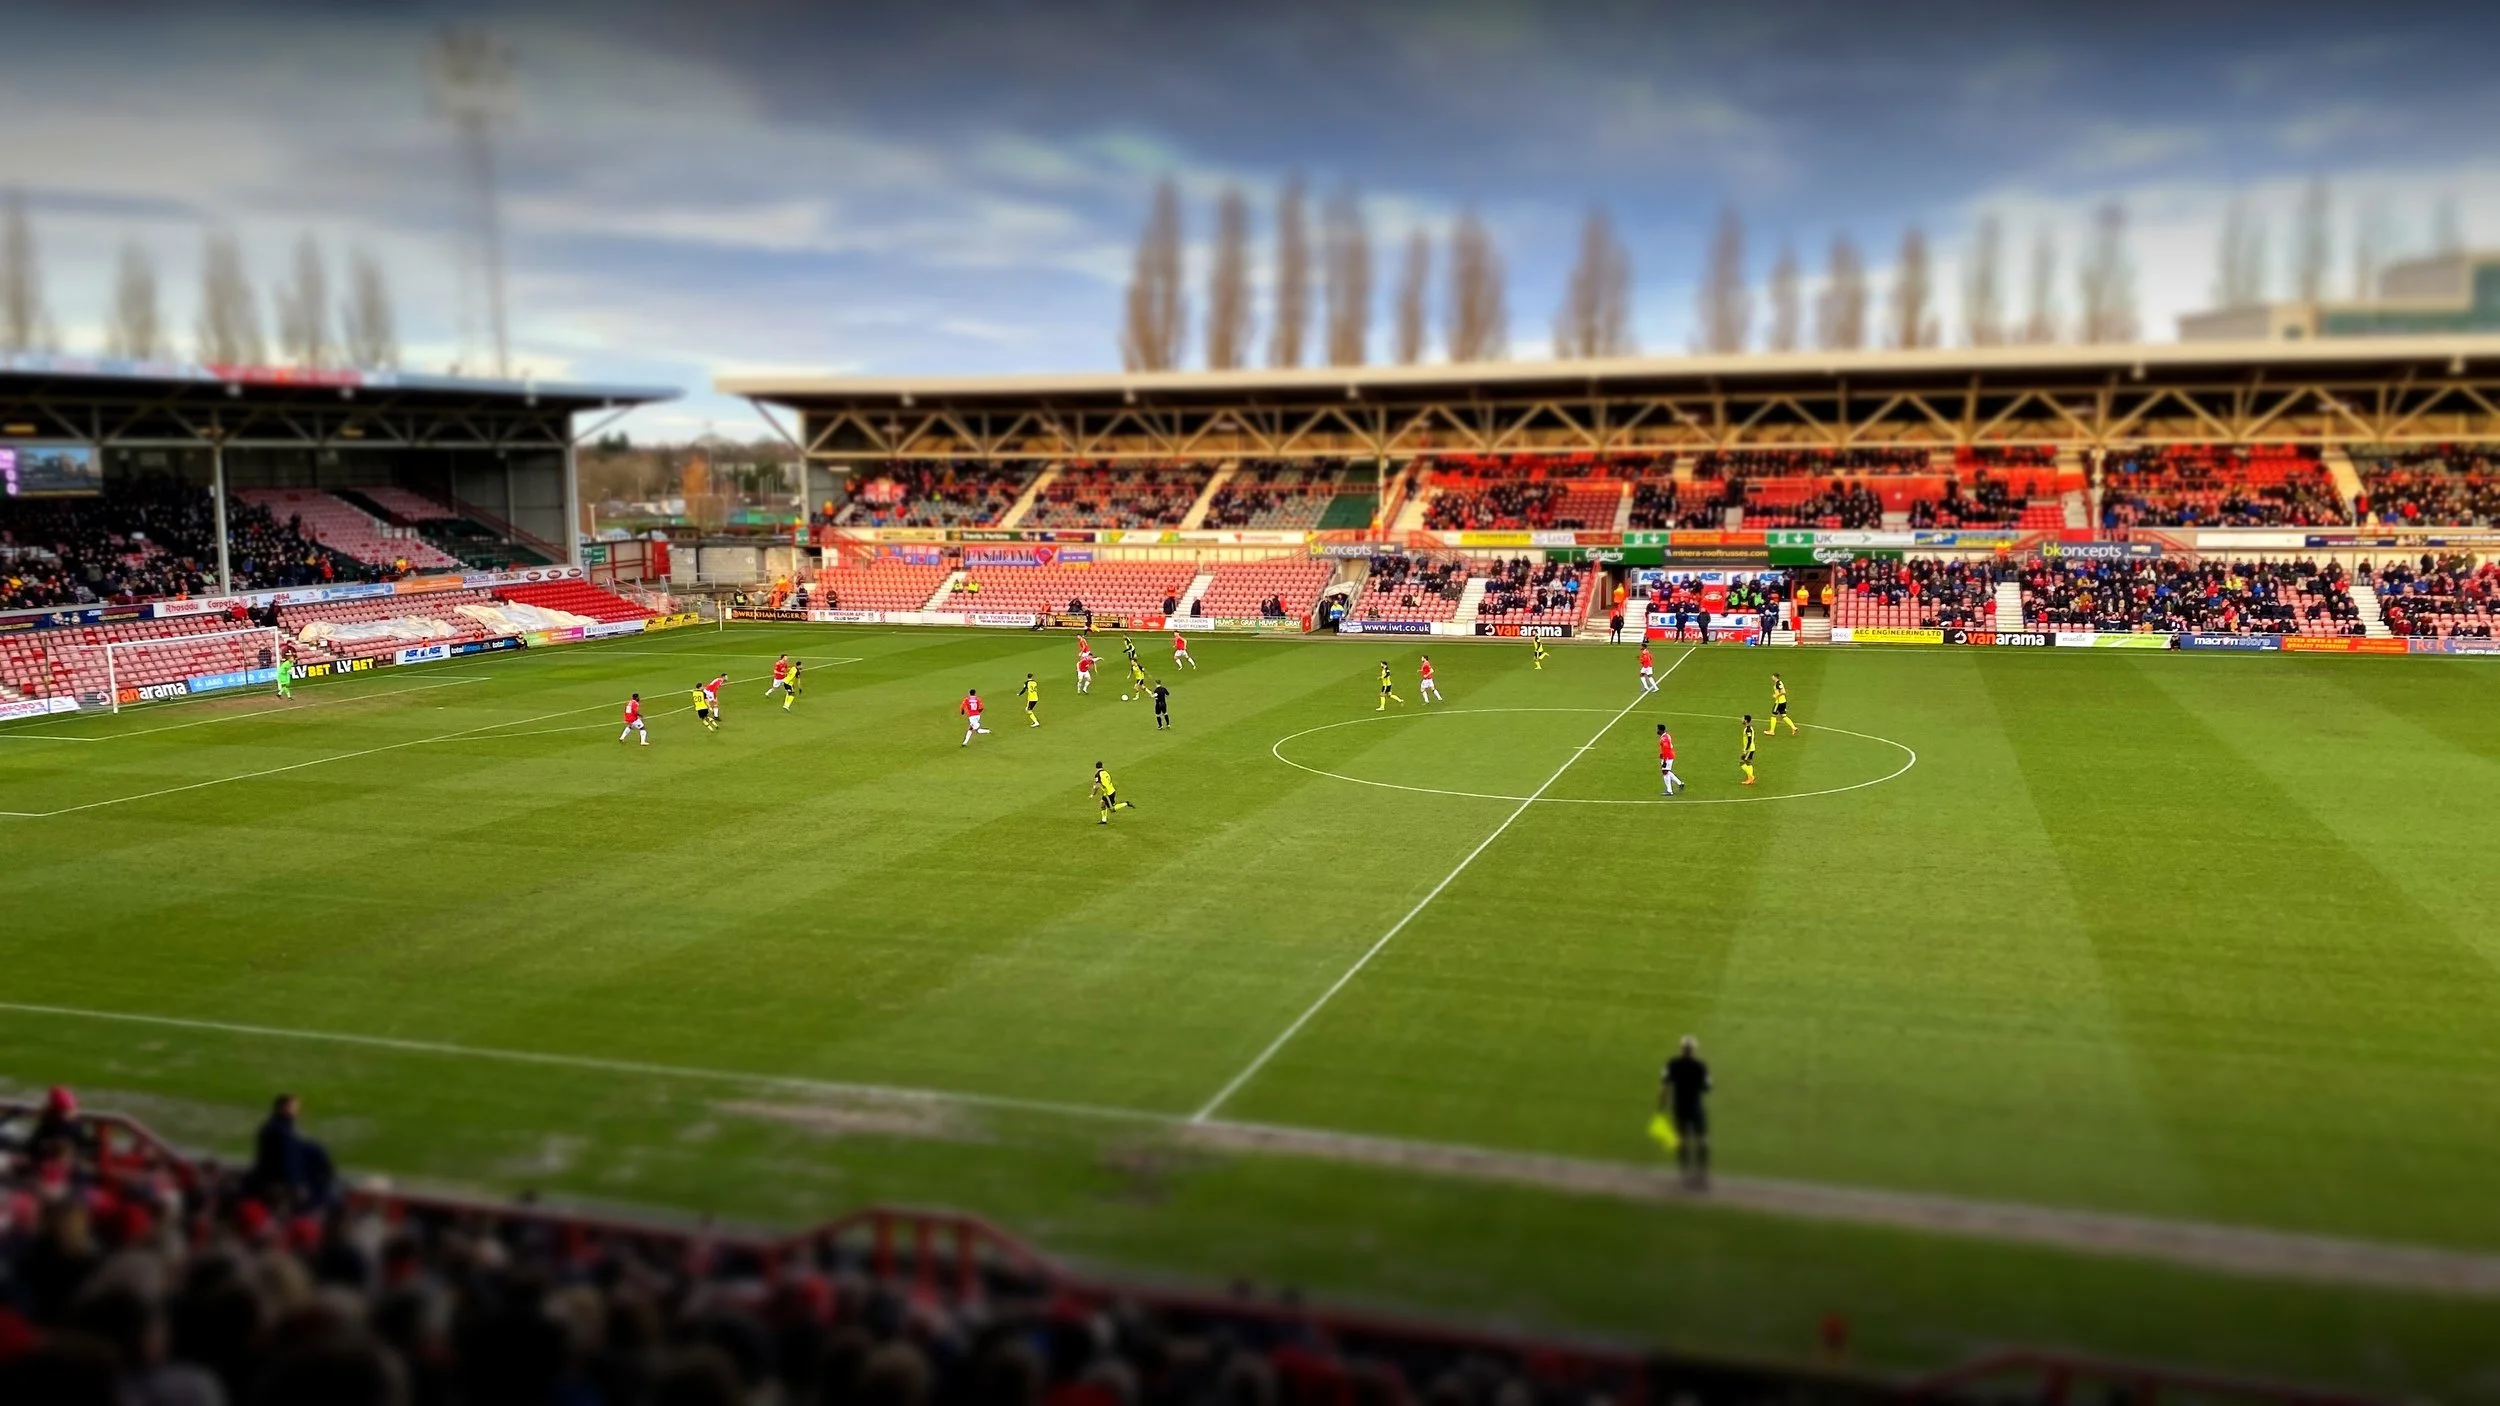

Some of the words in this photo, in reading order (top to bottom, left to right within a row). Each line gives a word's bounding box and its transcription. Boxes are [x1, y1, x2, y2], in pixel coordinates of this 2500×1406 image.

[963, 532, 983, 540] Travis
[985, 532, 1010, 540] Perkins
[1309, 542, 1372, 557] bkoncepts
[1585, 548, 1624, 562] Carlsberg
[1672, 549, 1769, 558] minera-rooftrusses.com
[2043, 542, 2122, 559] bkoncepts
[1812, 548, 1855, 563] Carlsberg
[165, 602, 199, 613] Rhosddu
[738, 610, 776, 620] WREXHAM
[777, 610, 800, 620] LAGER
[1240, 619, 1257, 627] GRAY
[1258, 619, 1279, 627] HUWS
[1364, 622, 1430, 633] www.iwt.co.uk
[1716, 631, 1735, 640] AFC
[1968, 633, 2045, 646] vanarama
[308, 663, 331, 677] BET
[352, 658, 374, 672] BET
